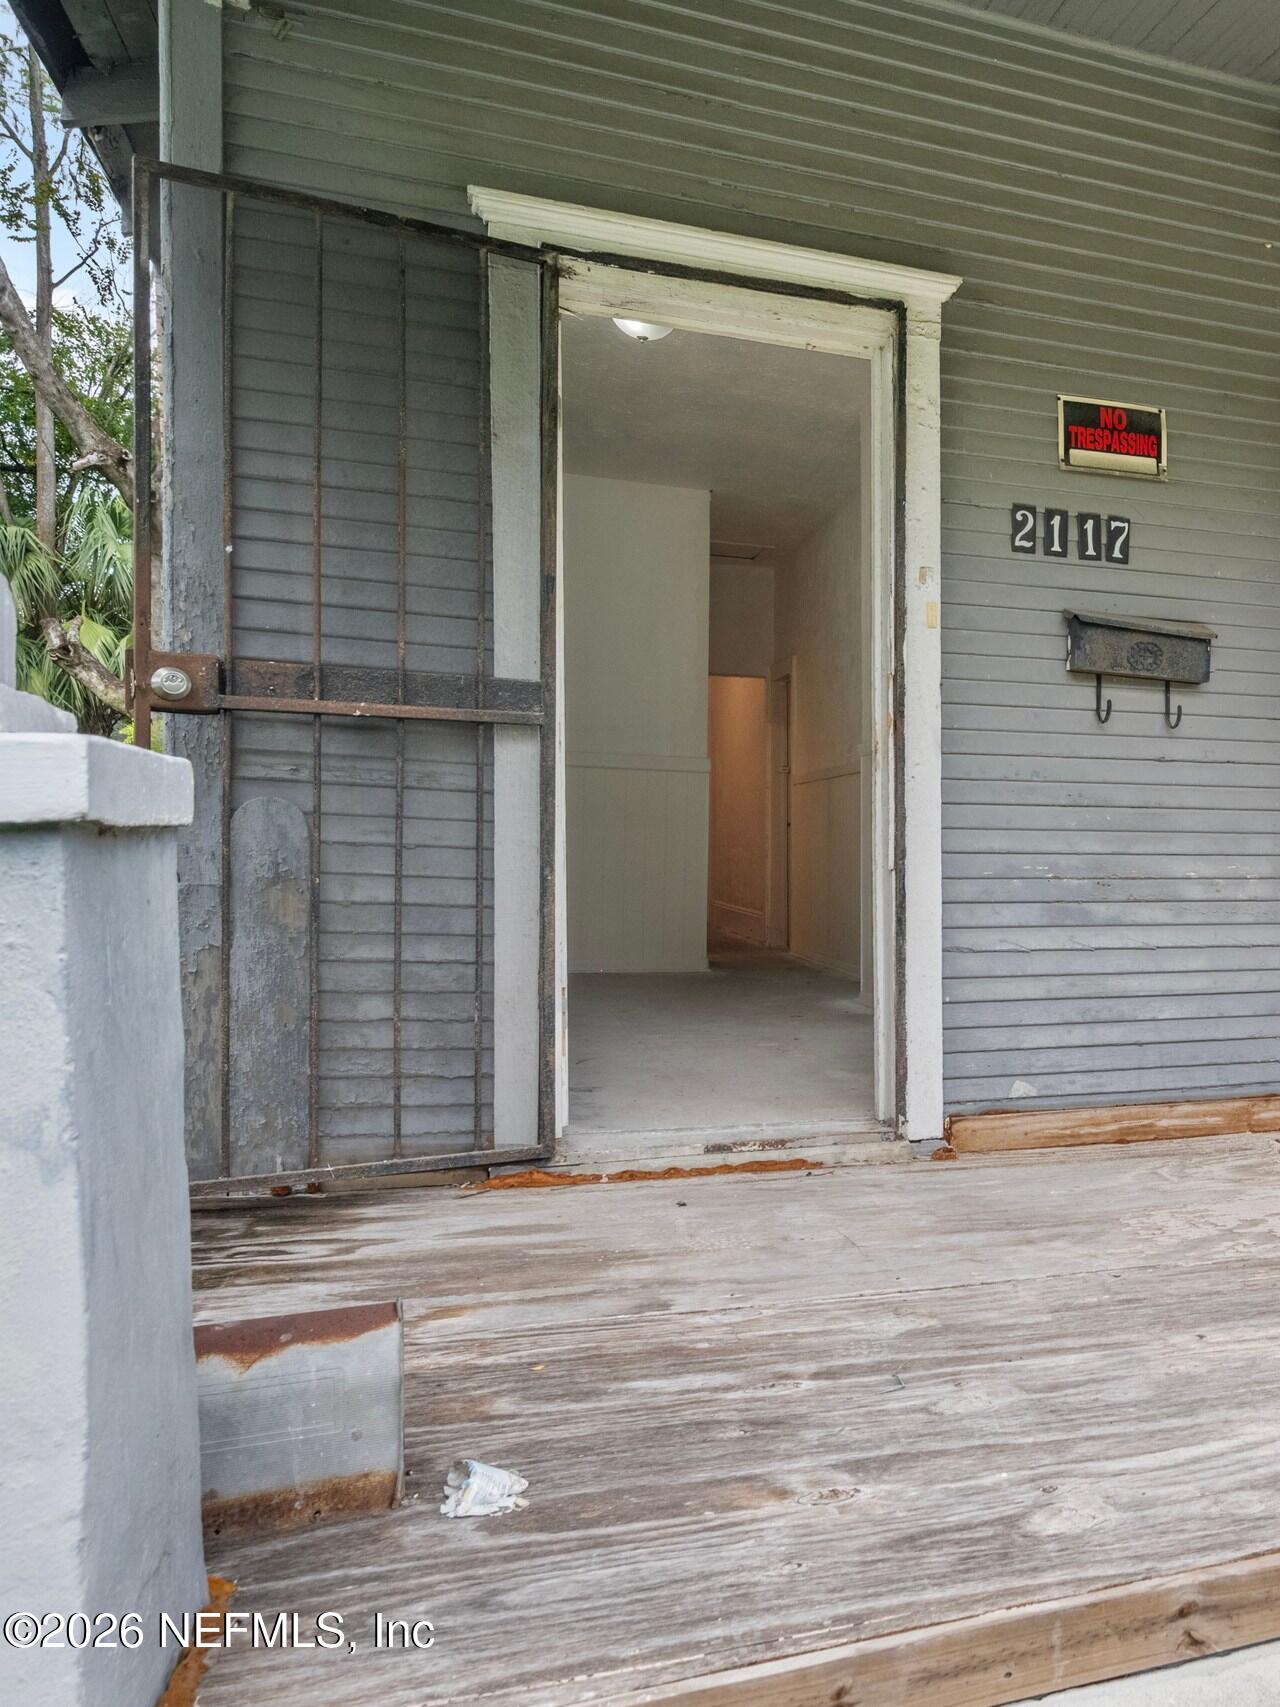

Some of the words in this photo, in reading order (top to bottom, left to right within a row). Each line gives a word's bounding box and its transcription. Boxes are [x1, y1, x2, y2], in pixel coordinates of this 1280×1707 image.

[1099, 406, 1127, 431] NO
[1068, 424, 1158, 457] TRESPASSING
[1013, 509, 1129, 559] 2117
